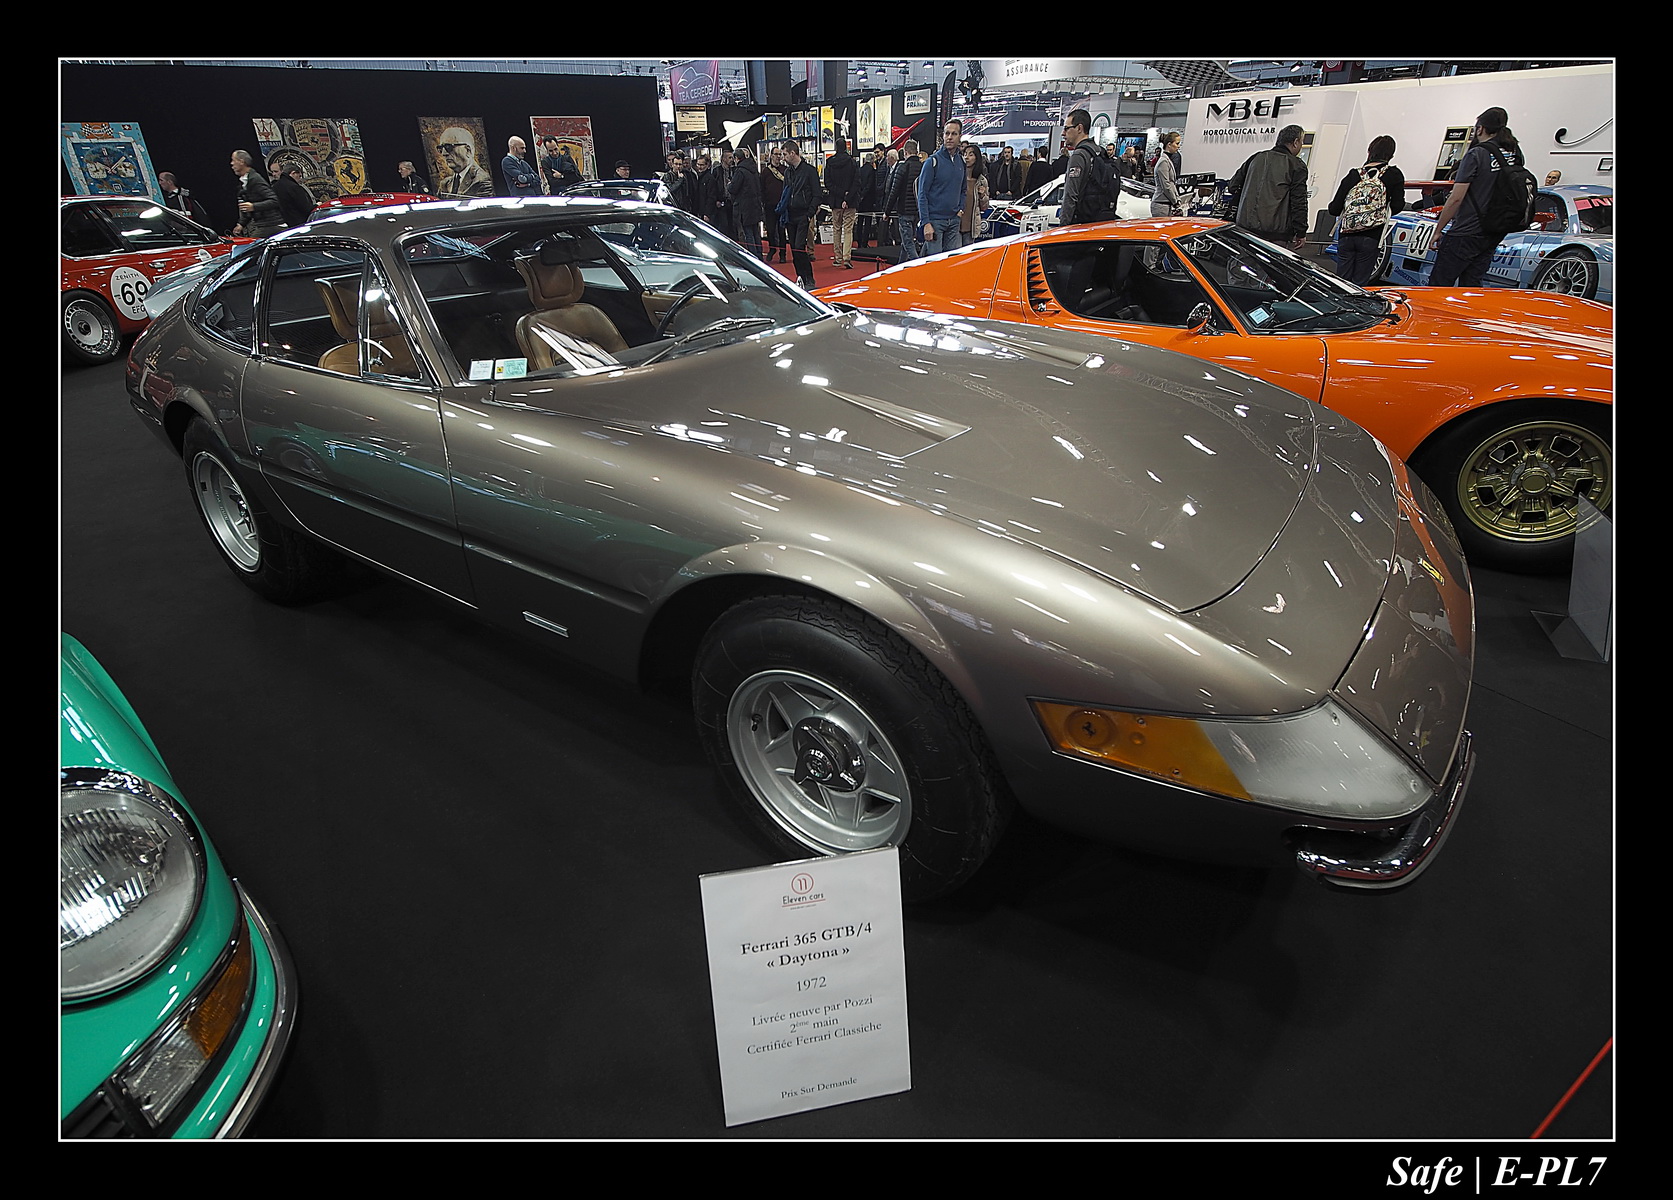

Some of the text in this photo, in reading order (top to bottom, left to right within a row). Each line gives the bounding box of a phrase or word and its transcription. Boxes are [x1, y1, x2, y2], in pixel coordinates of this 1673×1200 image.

[1006, 63, 1048, 78] ASSURANCE
[906, 94, 917, 102] AIR
[1206, 95, 1301, 121] MB&F
[1203, 128, 1257, 136] HOROLOGICAL
[1025, 222, 1043, 233] 51
[1409, 223, 1434, 256] 30
[115, 273, 140, 281] ZENITH
[121, 280, 149, 306] 69
[782, 893, 824, 905] Eleven cars
[741, 922, 872, 955] Ferrari 365 GTB/4
[779, 949, 838, 967] Daytona
[796, 976, 827, 991] 1972
[752, 994, 873, 1026] Livrée neuve par Pozzi
[812, 1017, 839, 1029] main
[747, 1021, 882, 1055] Certifiée Ferrari Classiche
[781, 1077, 857, 1099] Prix Sur Demande
